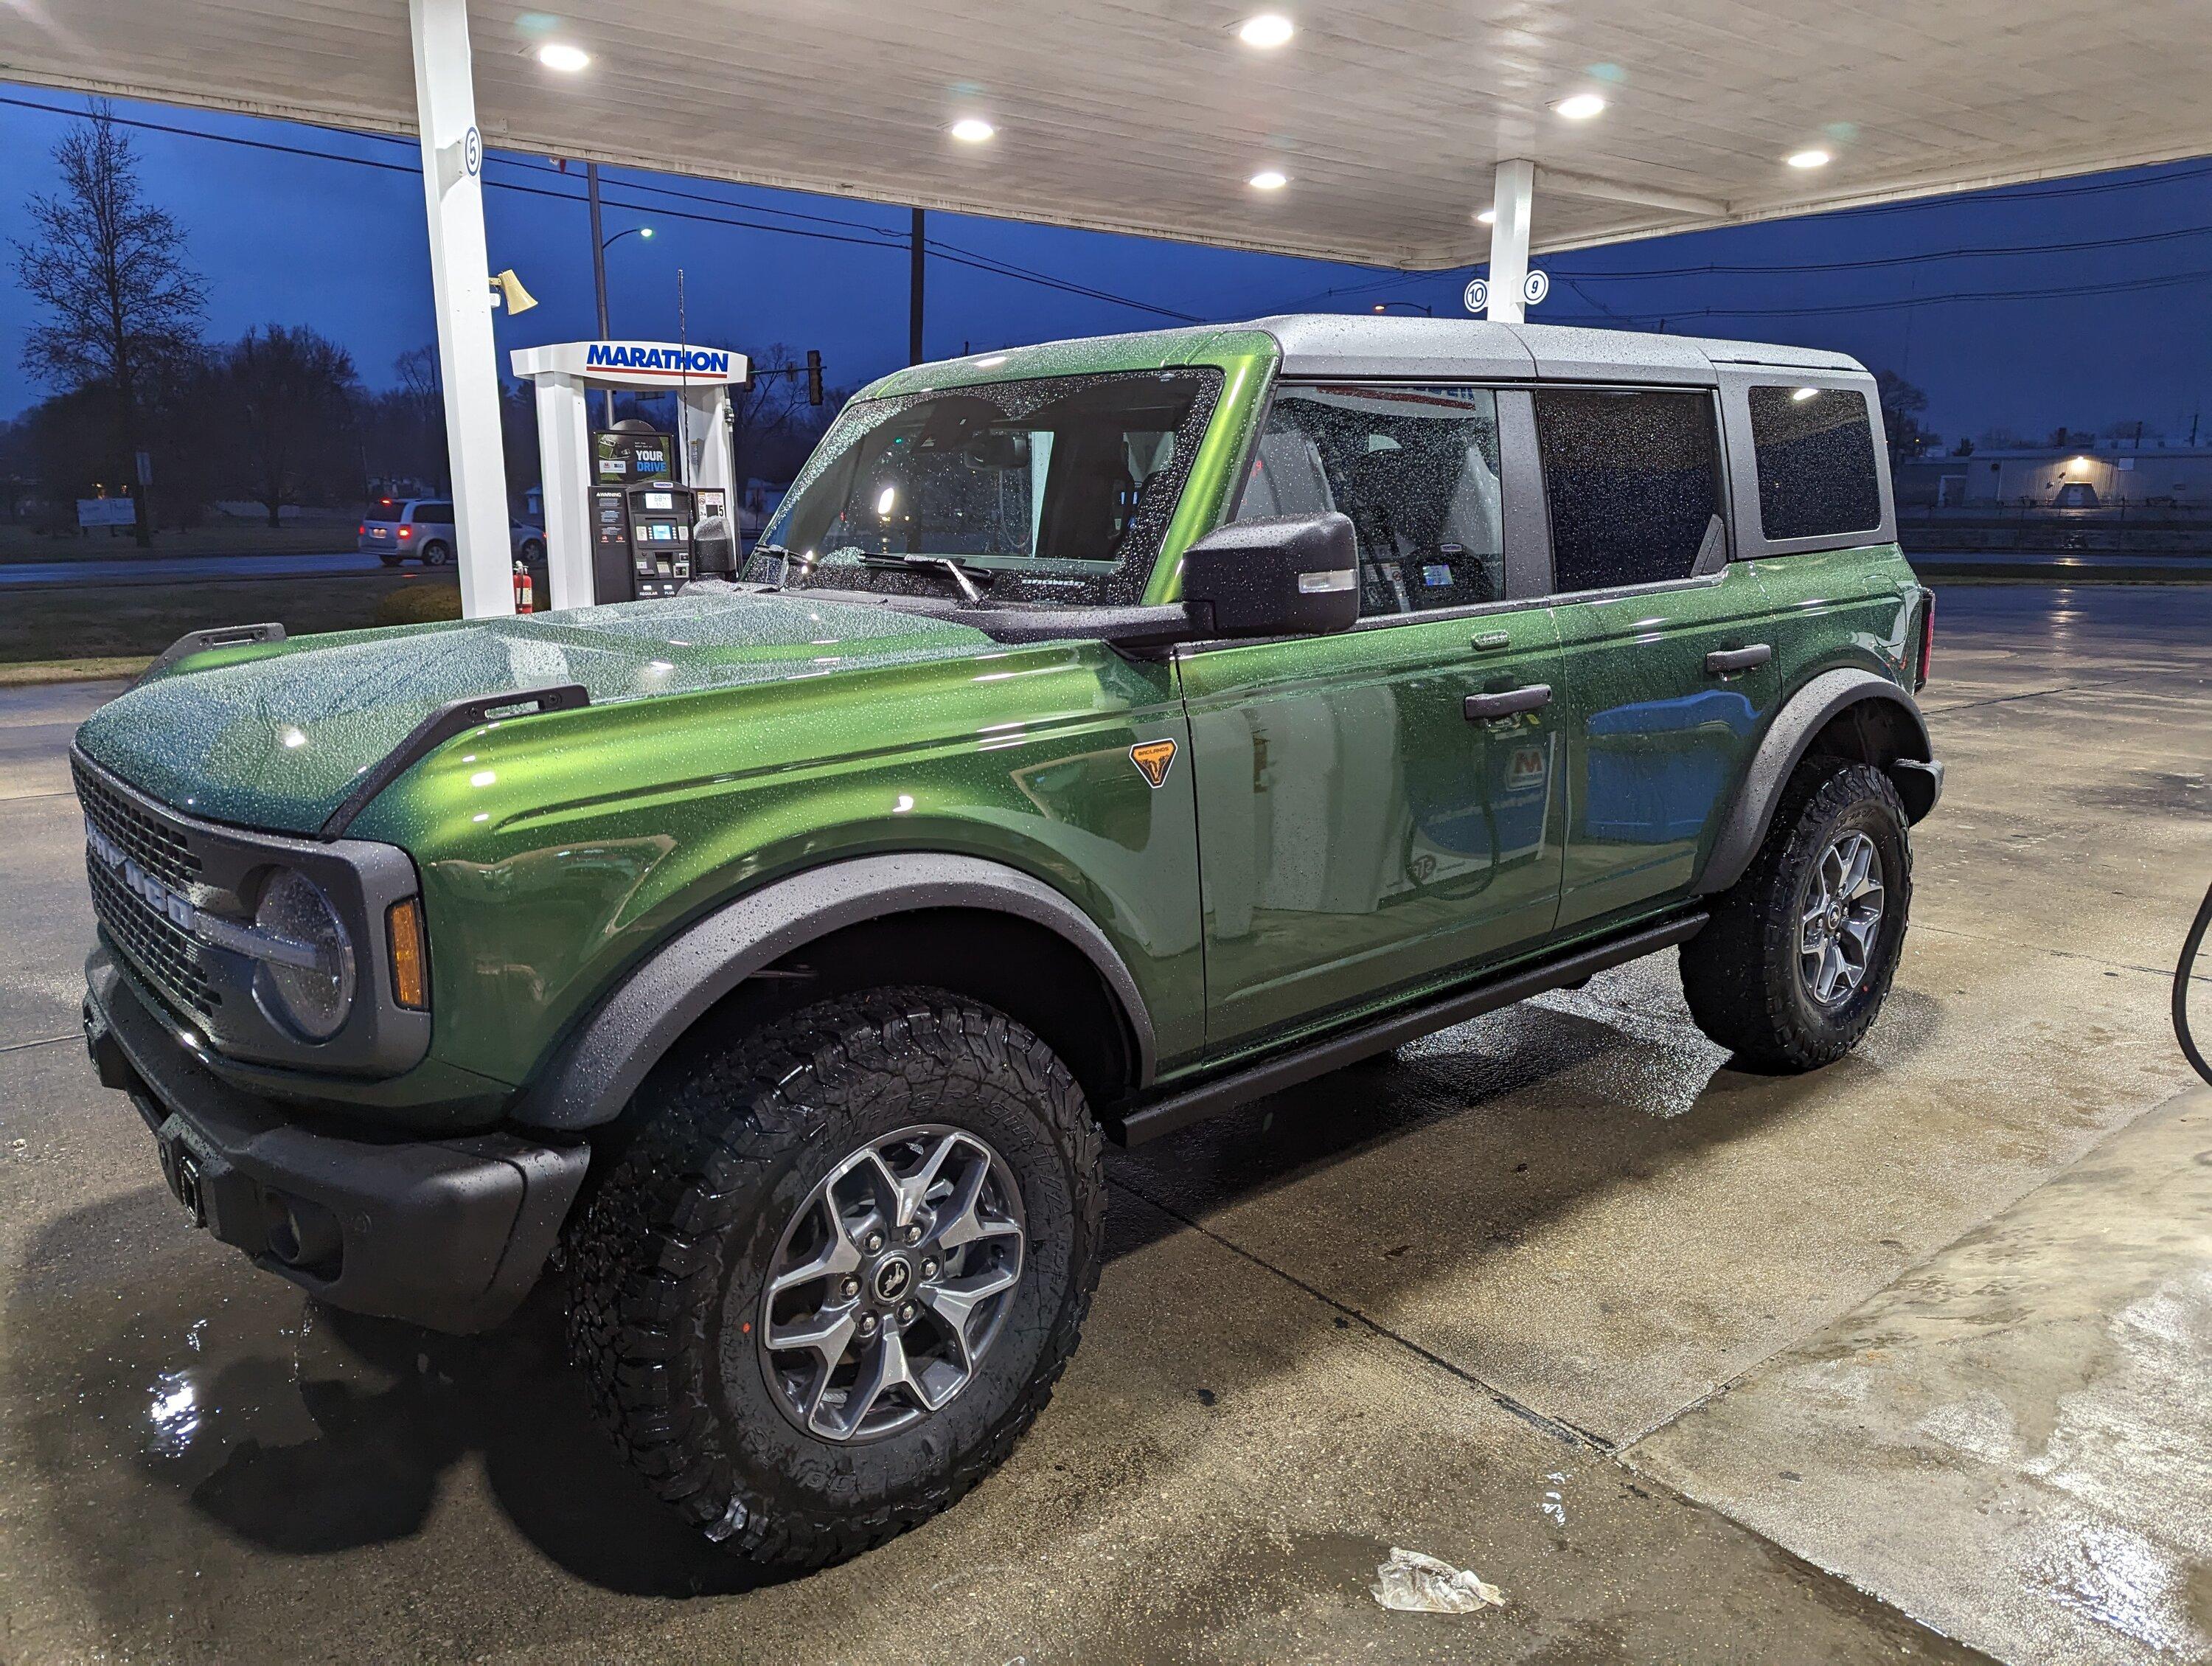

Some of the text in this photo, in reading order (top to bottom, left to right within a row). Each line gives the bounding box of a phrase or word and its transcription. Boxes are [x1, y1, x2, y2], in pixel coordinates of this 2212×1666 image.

[468, 136, 477, 165] 5
[1531, 280, 1539, 294] 9
[1469, 287, 1485, 304] 10
[586, 344, 728, 372] MARATHON
[636, 450, 663, 461] YOUR
[636, 461, 667, 472] DRIVE
[719, 505, 724, 516] 5
[1021, 578, 1086, 587] BRONCO
[1138, 746, 1169, 756] BADLANDS
